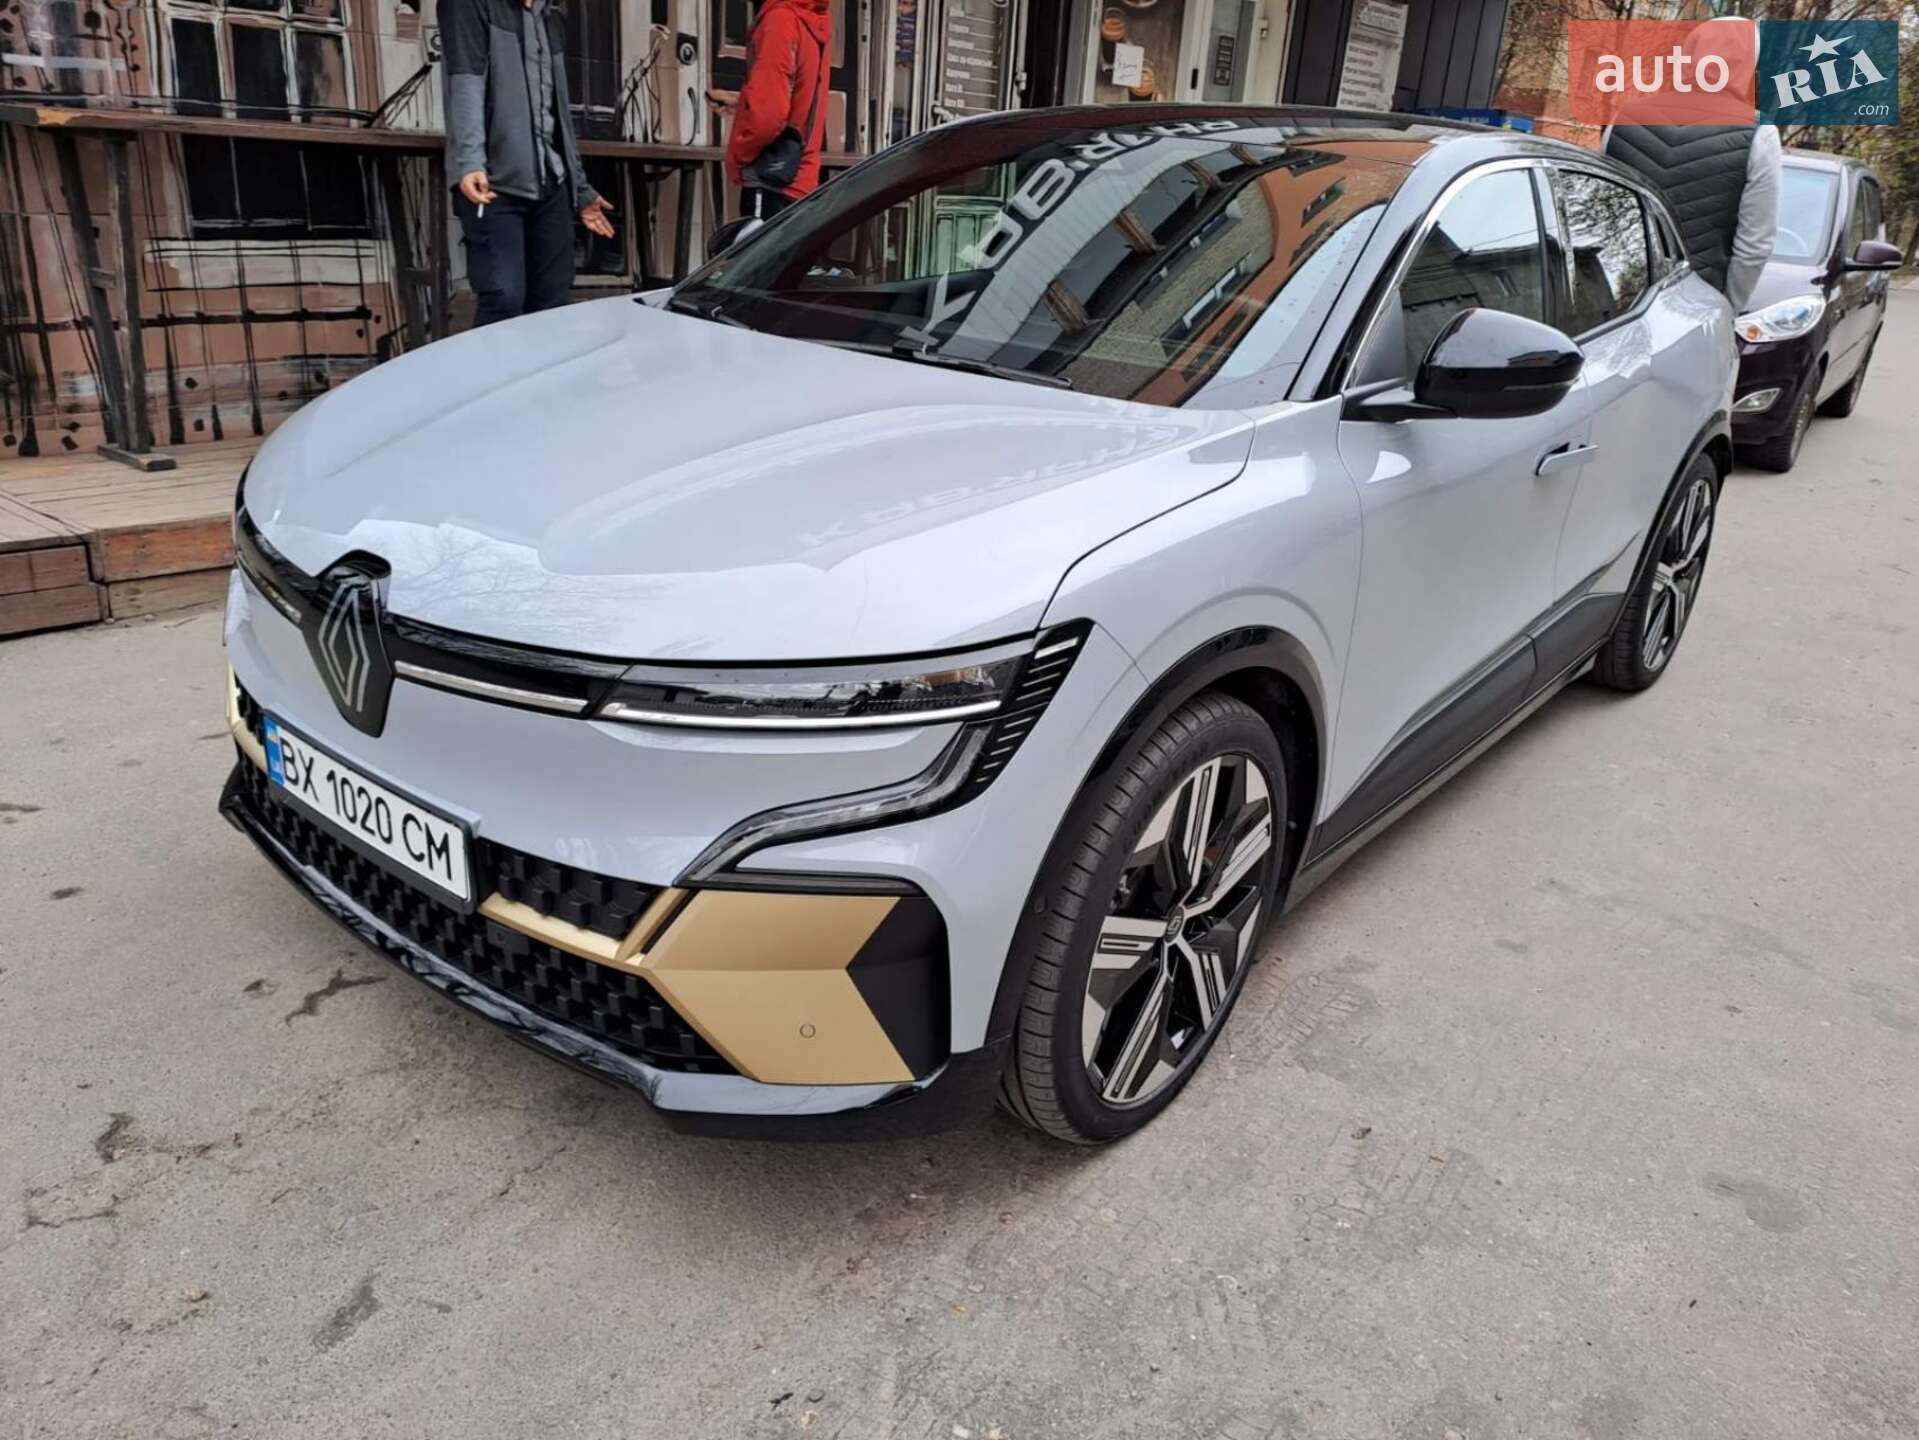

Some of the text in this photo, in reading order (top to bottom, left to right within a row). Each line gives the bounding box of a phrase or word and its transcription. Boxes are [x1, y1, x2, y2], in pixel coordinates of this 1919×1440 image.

[279, 738, 452, 881] BX 1020 CM
